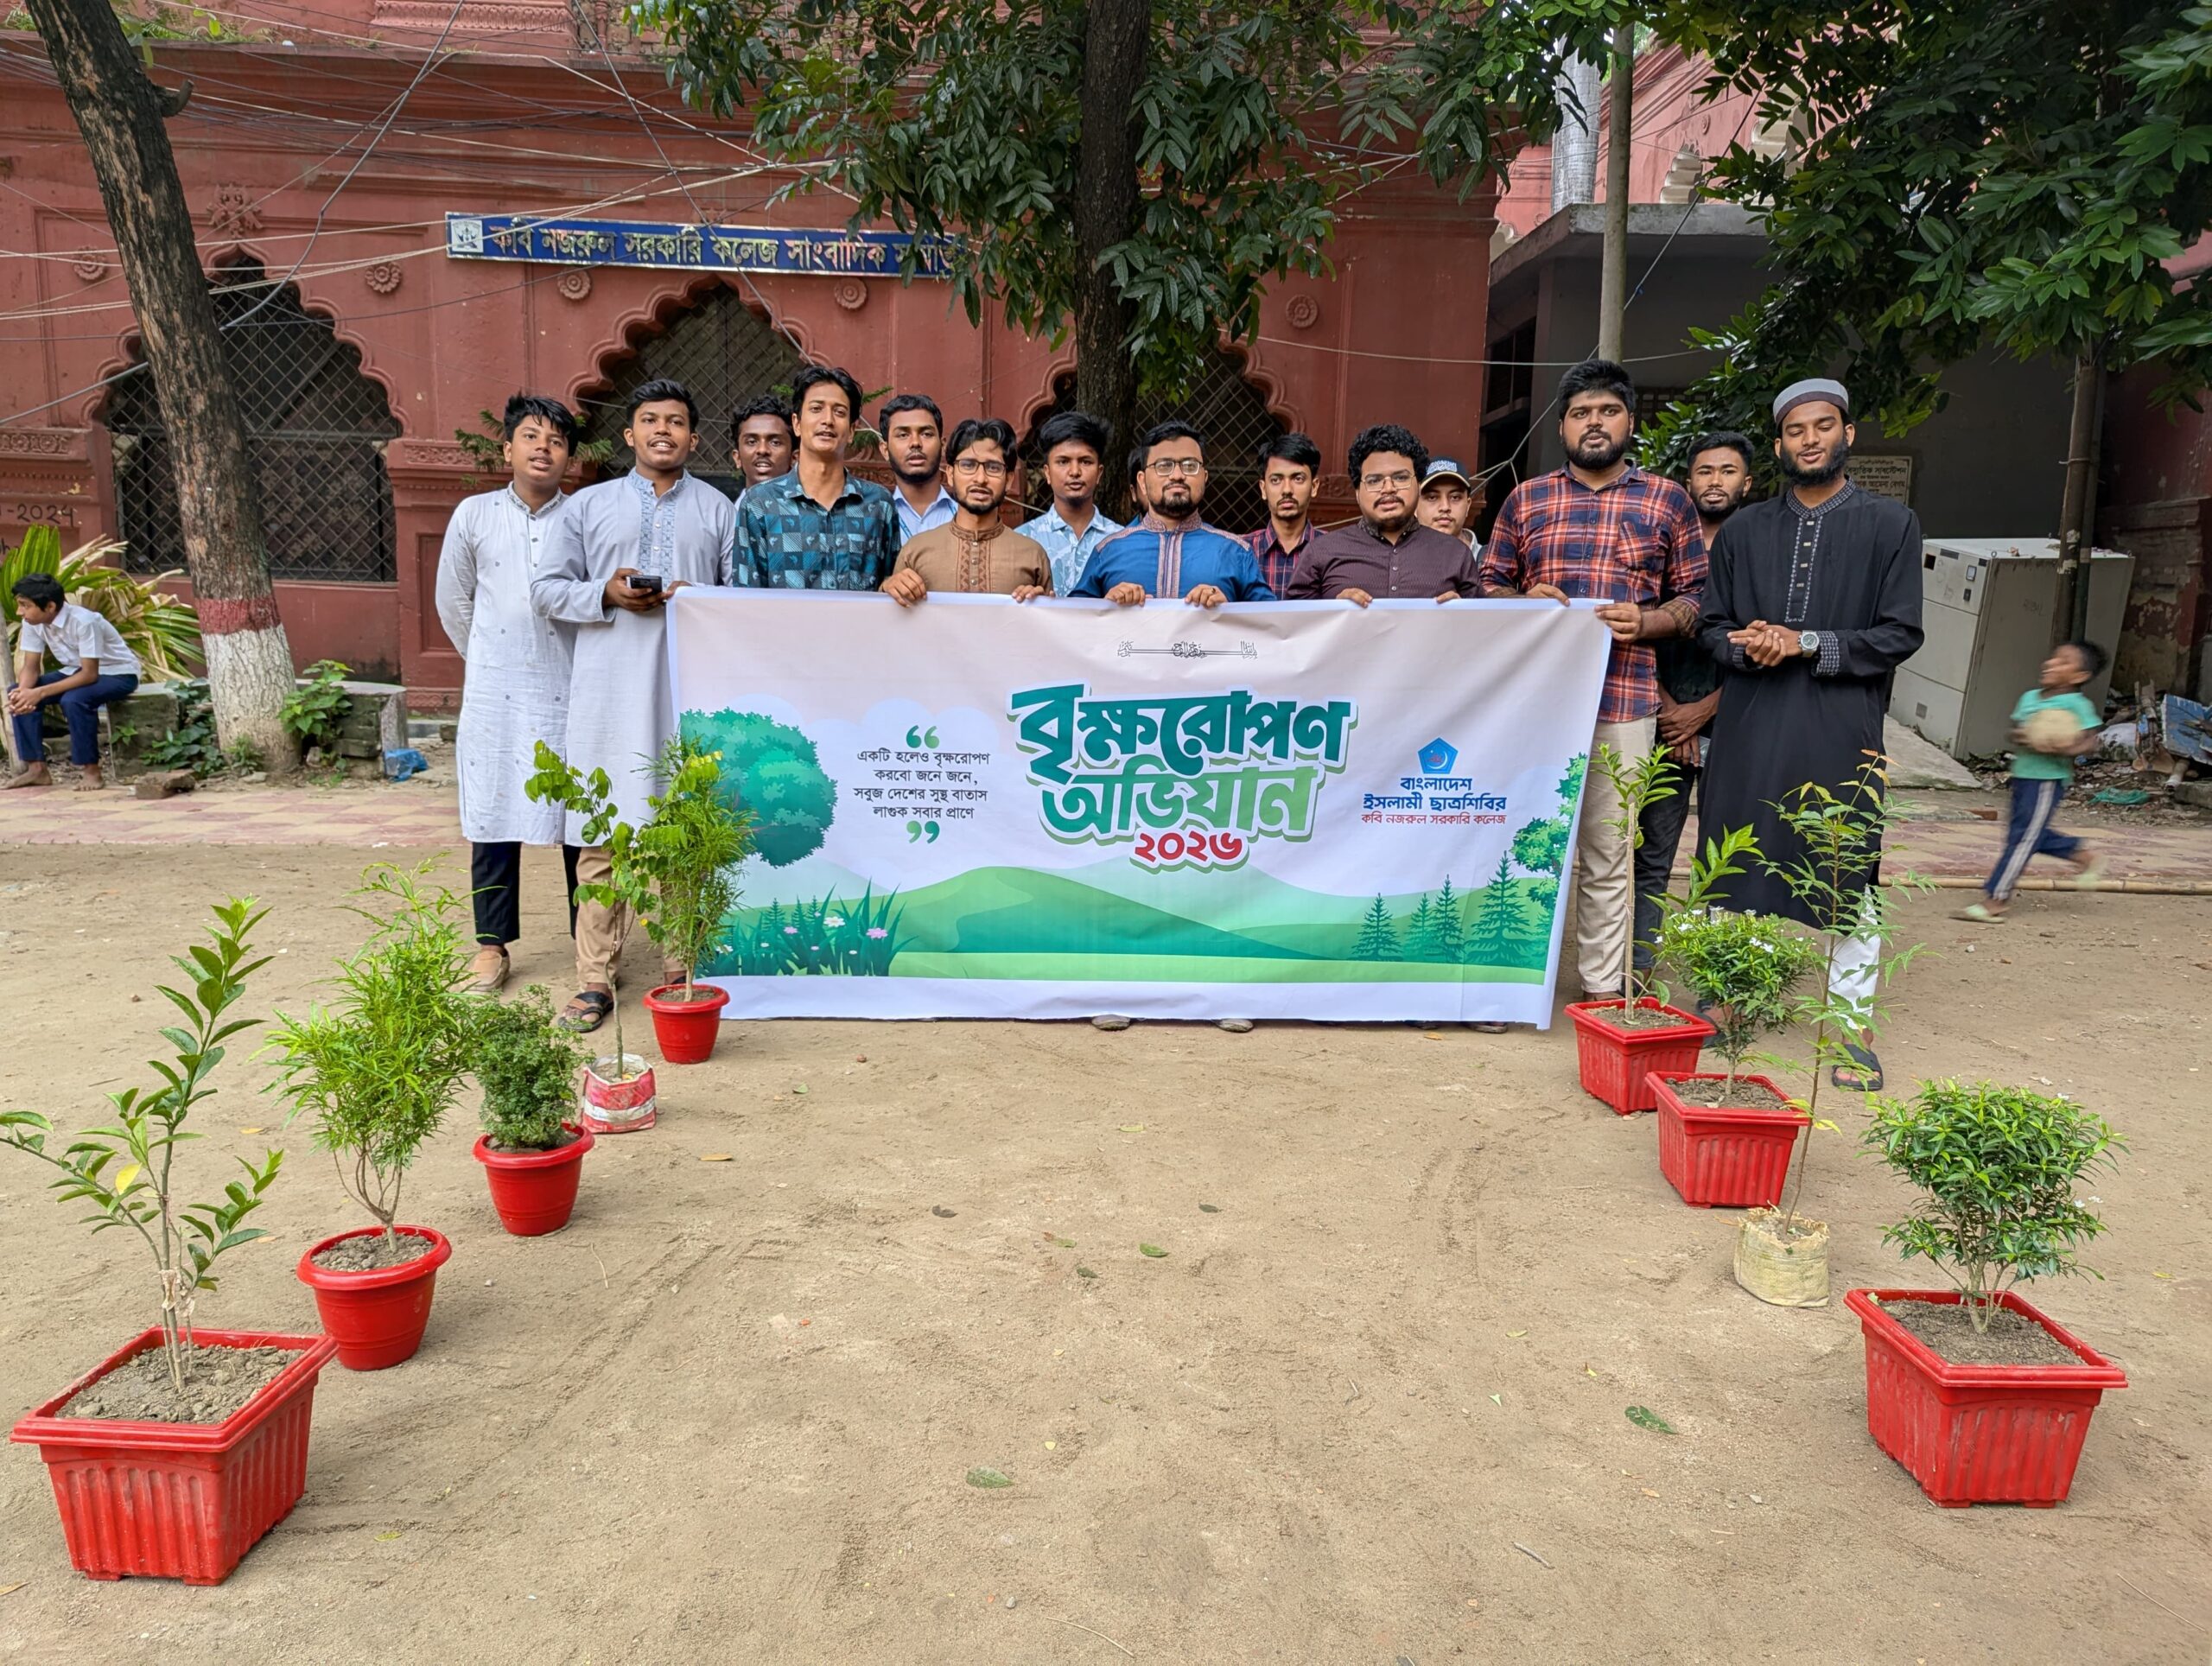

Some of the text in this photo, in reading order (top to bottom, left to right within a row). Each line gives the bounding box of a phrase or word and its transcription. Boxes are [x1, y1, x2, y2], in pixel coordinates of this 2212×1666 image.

[489, 217, 534, 257] কবি
[538, 227, 618, 260] নজরুল
[621, 225, 704, 264] সরকারি
[709, 235, 779, 266] কলেজ
[784, 233, 887, 271] সাংবাদিক
[1011, 683, 1351, 785] বৃক্ষরোপণ
[857, 747, 990, 768] একটি হলেও বৃক্ষরোপণ
[874, 769, 978, 785] করবো জনে জনে,
[1400, 778, 1472, 792] বাংলাদেশ
[853, 788, 884, 802] সবুজ
[887, 788, 926, 800] দেশের
[951, 789, 988, 802] বাতাস
[1041, 754, 1319, 835] অভিযান
[1363, 792, 1507, 811] ইসলামী ছাত্রশিবির
[873, 806, 975, 819] লাগুক সবার প্রাণে
[1361, 810, 1507, 824] কবি নজরুল সরকারি কলেজ
[1135, 830, 1243, 862] ২০২৬
